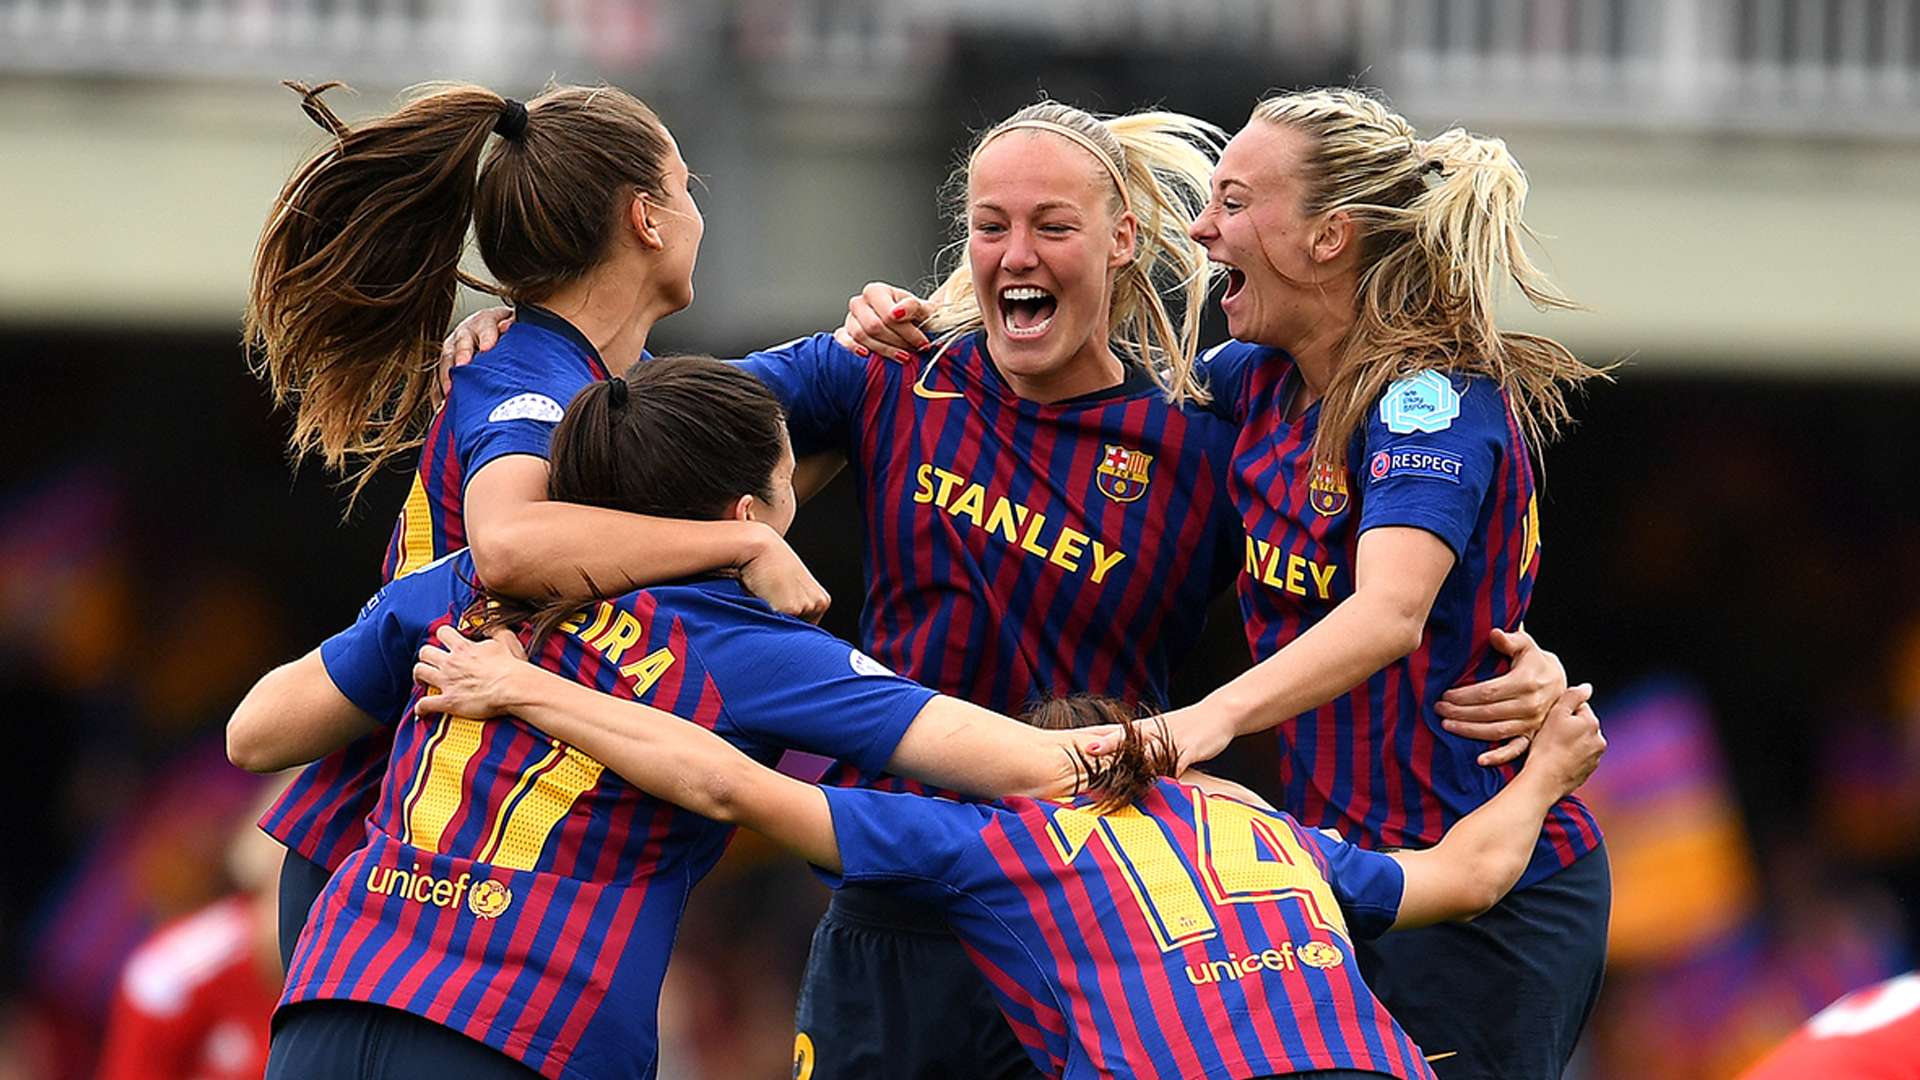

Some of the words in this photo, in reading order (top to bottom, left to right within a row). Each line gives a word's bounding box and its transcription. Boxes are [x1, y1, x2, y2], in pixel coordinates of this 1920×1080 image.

[1391, 453, 1463, 475] RESPECT
[913, 463, 1126, 584] STANLEY
[1245, 534, 1338, 600] NLEY
[366, 863, 471, 909] unicef
[1045, 787, 1355, 953] 14
[1184, 941, 1295, 985] unicef
